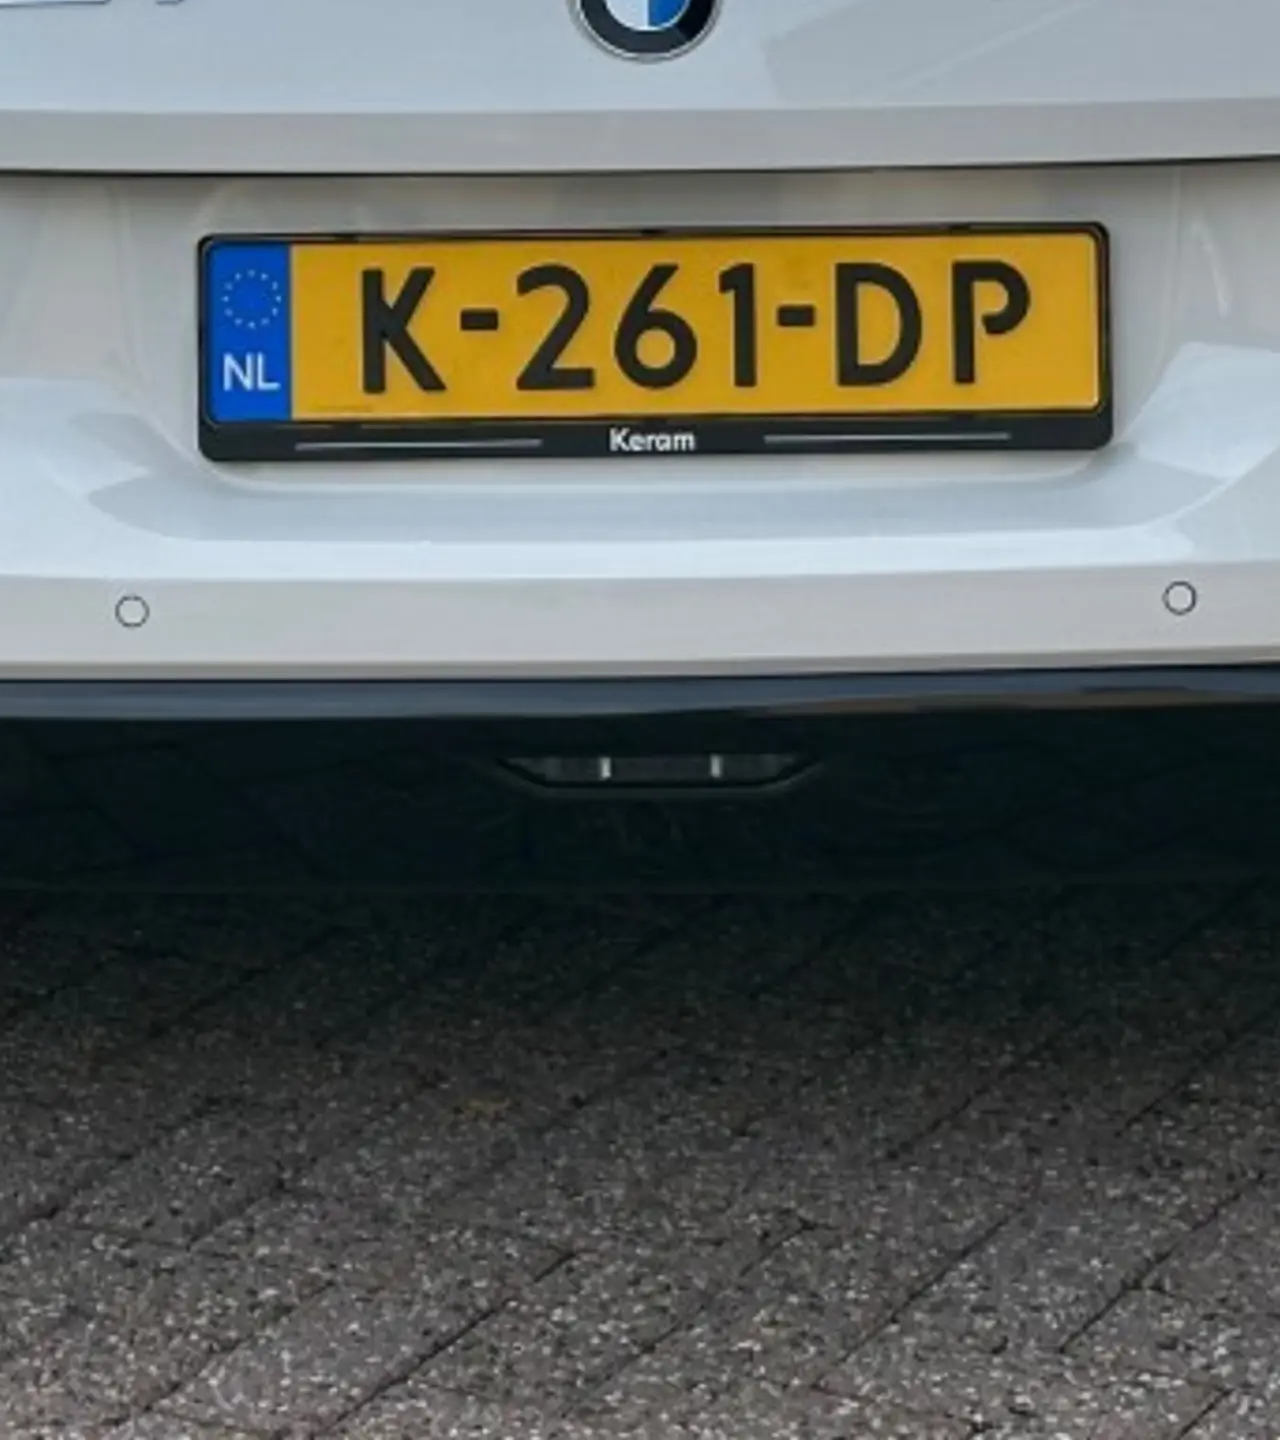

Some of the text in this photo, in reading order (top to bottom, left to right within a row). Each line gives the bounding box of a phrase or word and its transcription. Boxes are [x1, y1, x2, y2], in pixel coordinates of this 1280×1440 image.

[358, 258, 1032, 395] K-261-DP
[222, 352, 280, 391] NL
[609, 426, 696, 453] Keram
